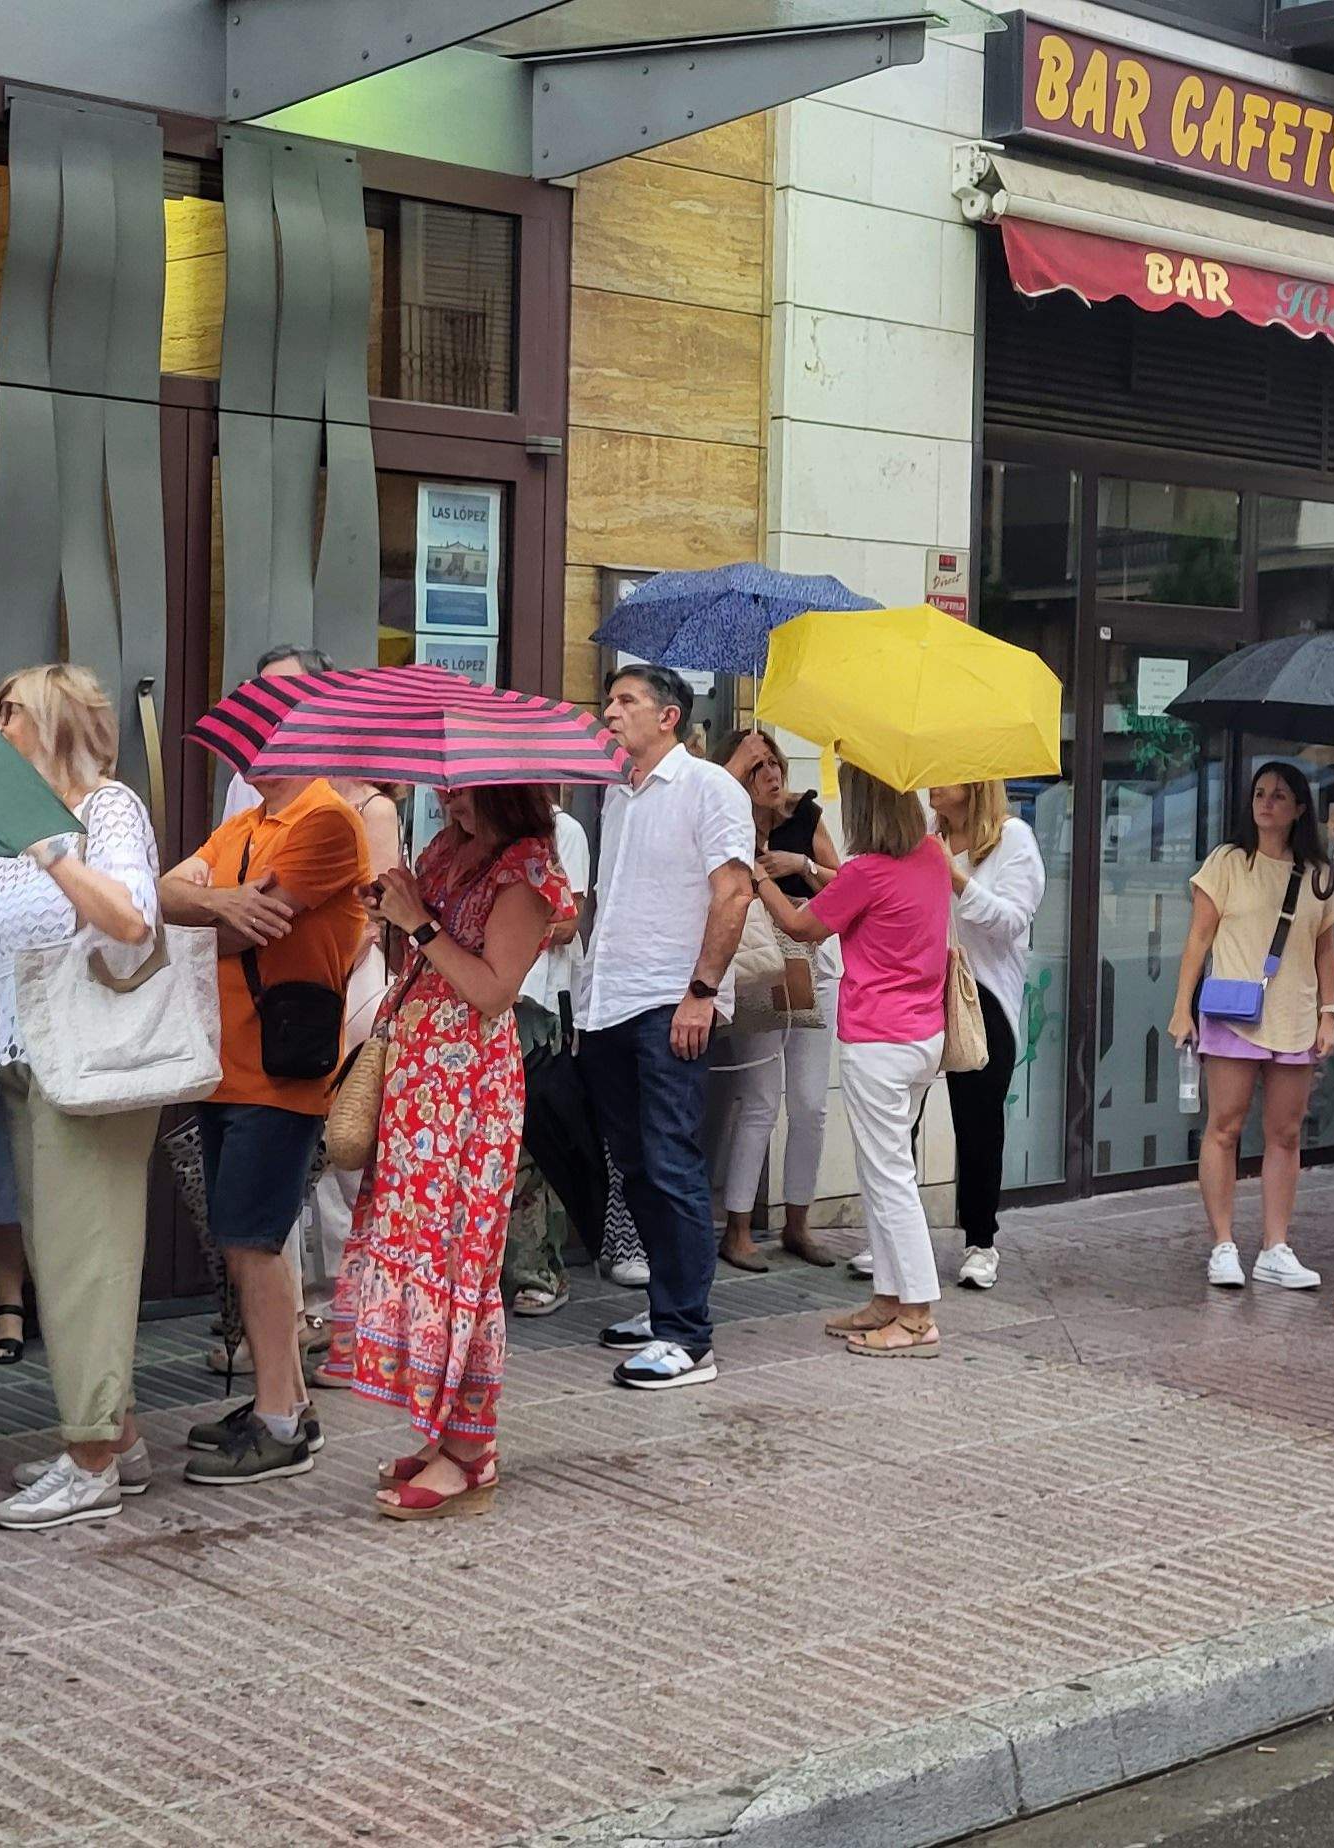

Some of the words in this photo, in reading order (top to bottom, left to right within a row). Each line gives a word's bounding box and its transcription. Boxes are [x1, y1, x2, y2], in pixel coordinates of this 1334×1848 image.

[1035, 34, 1152, 151] BAR
[1145, 252, 1234, 307] BAR
[432, 507, 451, 519] LAS
[453, 505, 487, 522] LÓPEZ
[452, 656, 485, 671] LÓPEZ
